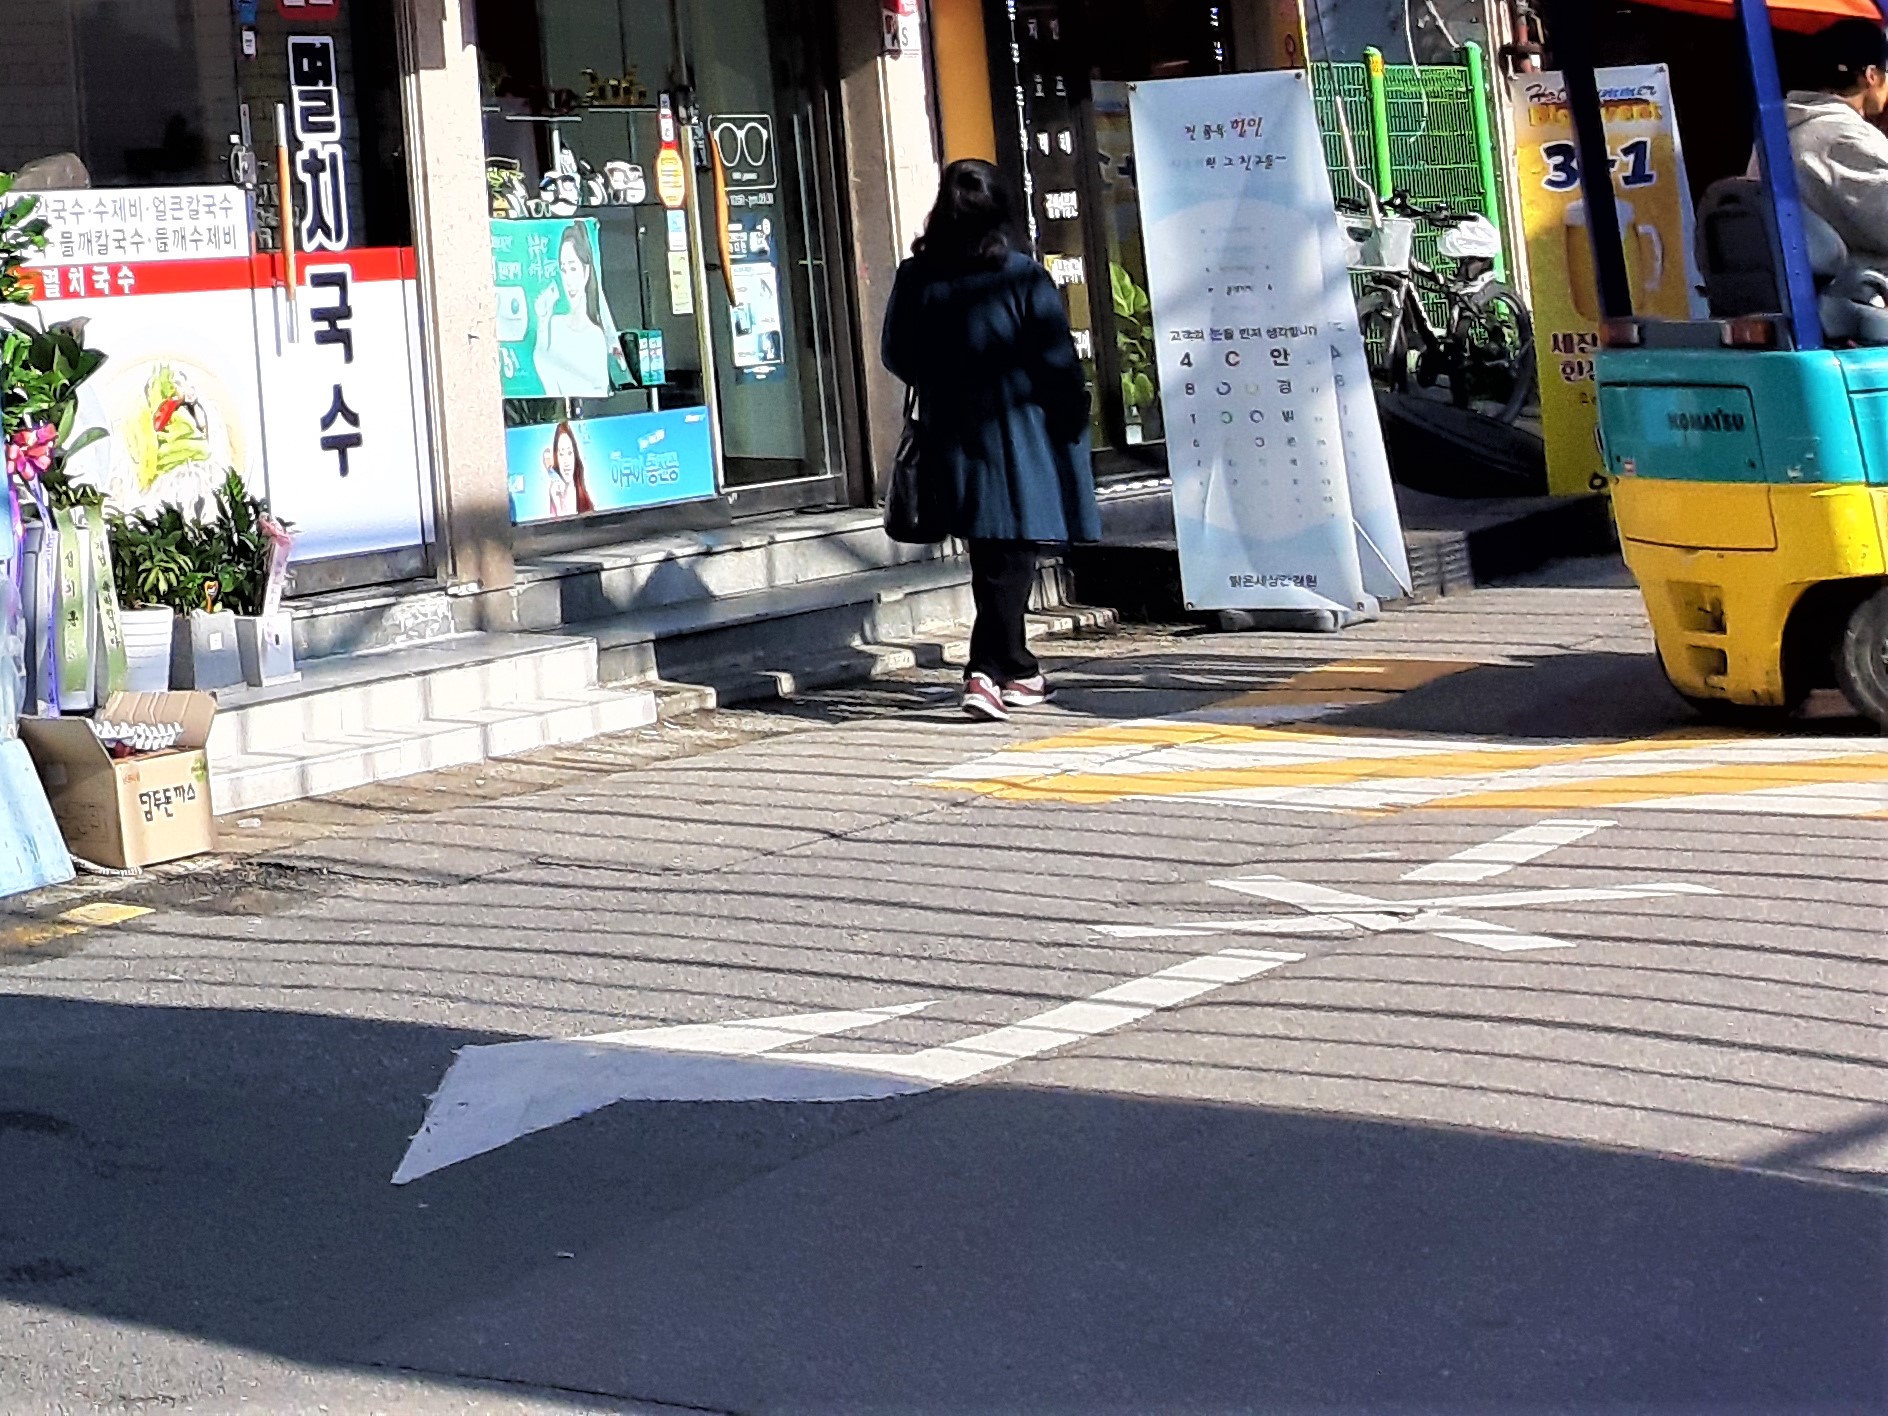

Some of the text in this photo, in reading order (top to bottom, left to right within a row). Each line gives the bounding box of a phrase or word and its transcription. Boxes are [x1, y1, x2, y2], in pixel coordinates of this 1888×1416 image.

[287, 35, 362, 477] 멸치국수
[41, 264, 135, 298] 멸치국수
[1180, 351, 1193, 367] 4
[1270, 347, 1291, 366] 안
[1668, 408, 1746, 432] KOMATSU
